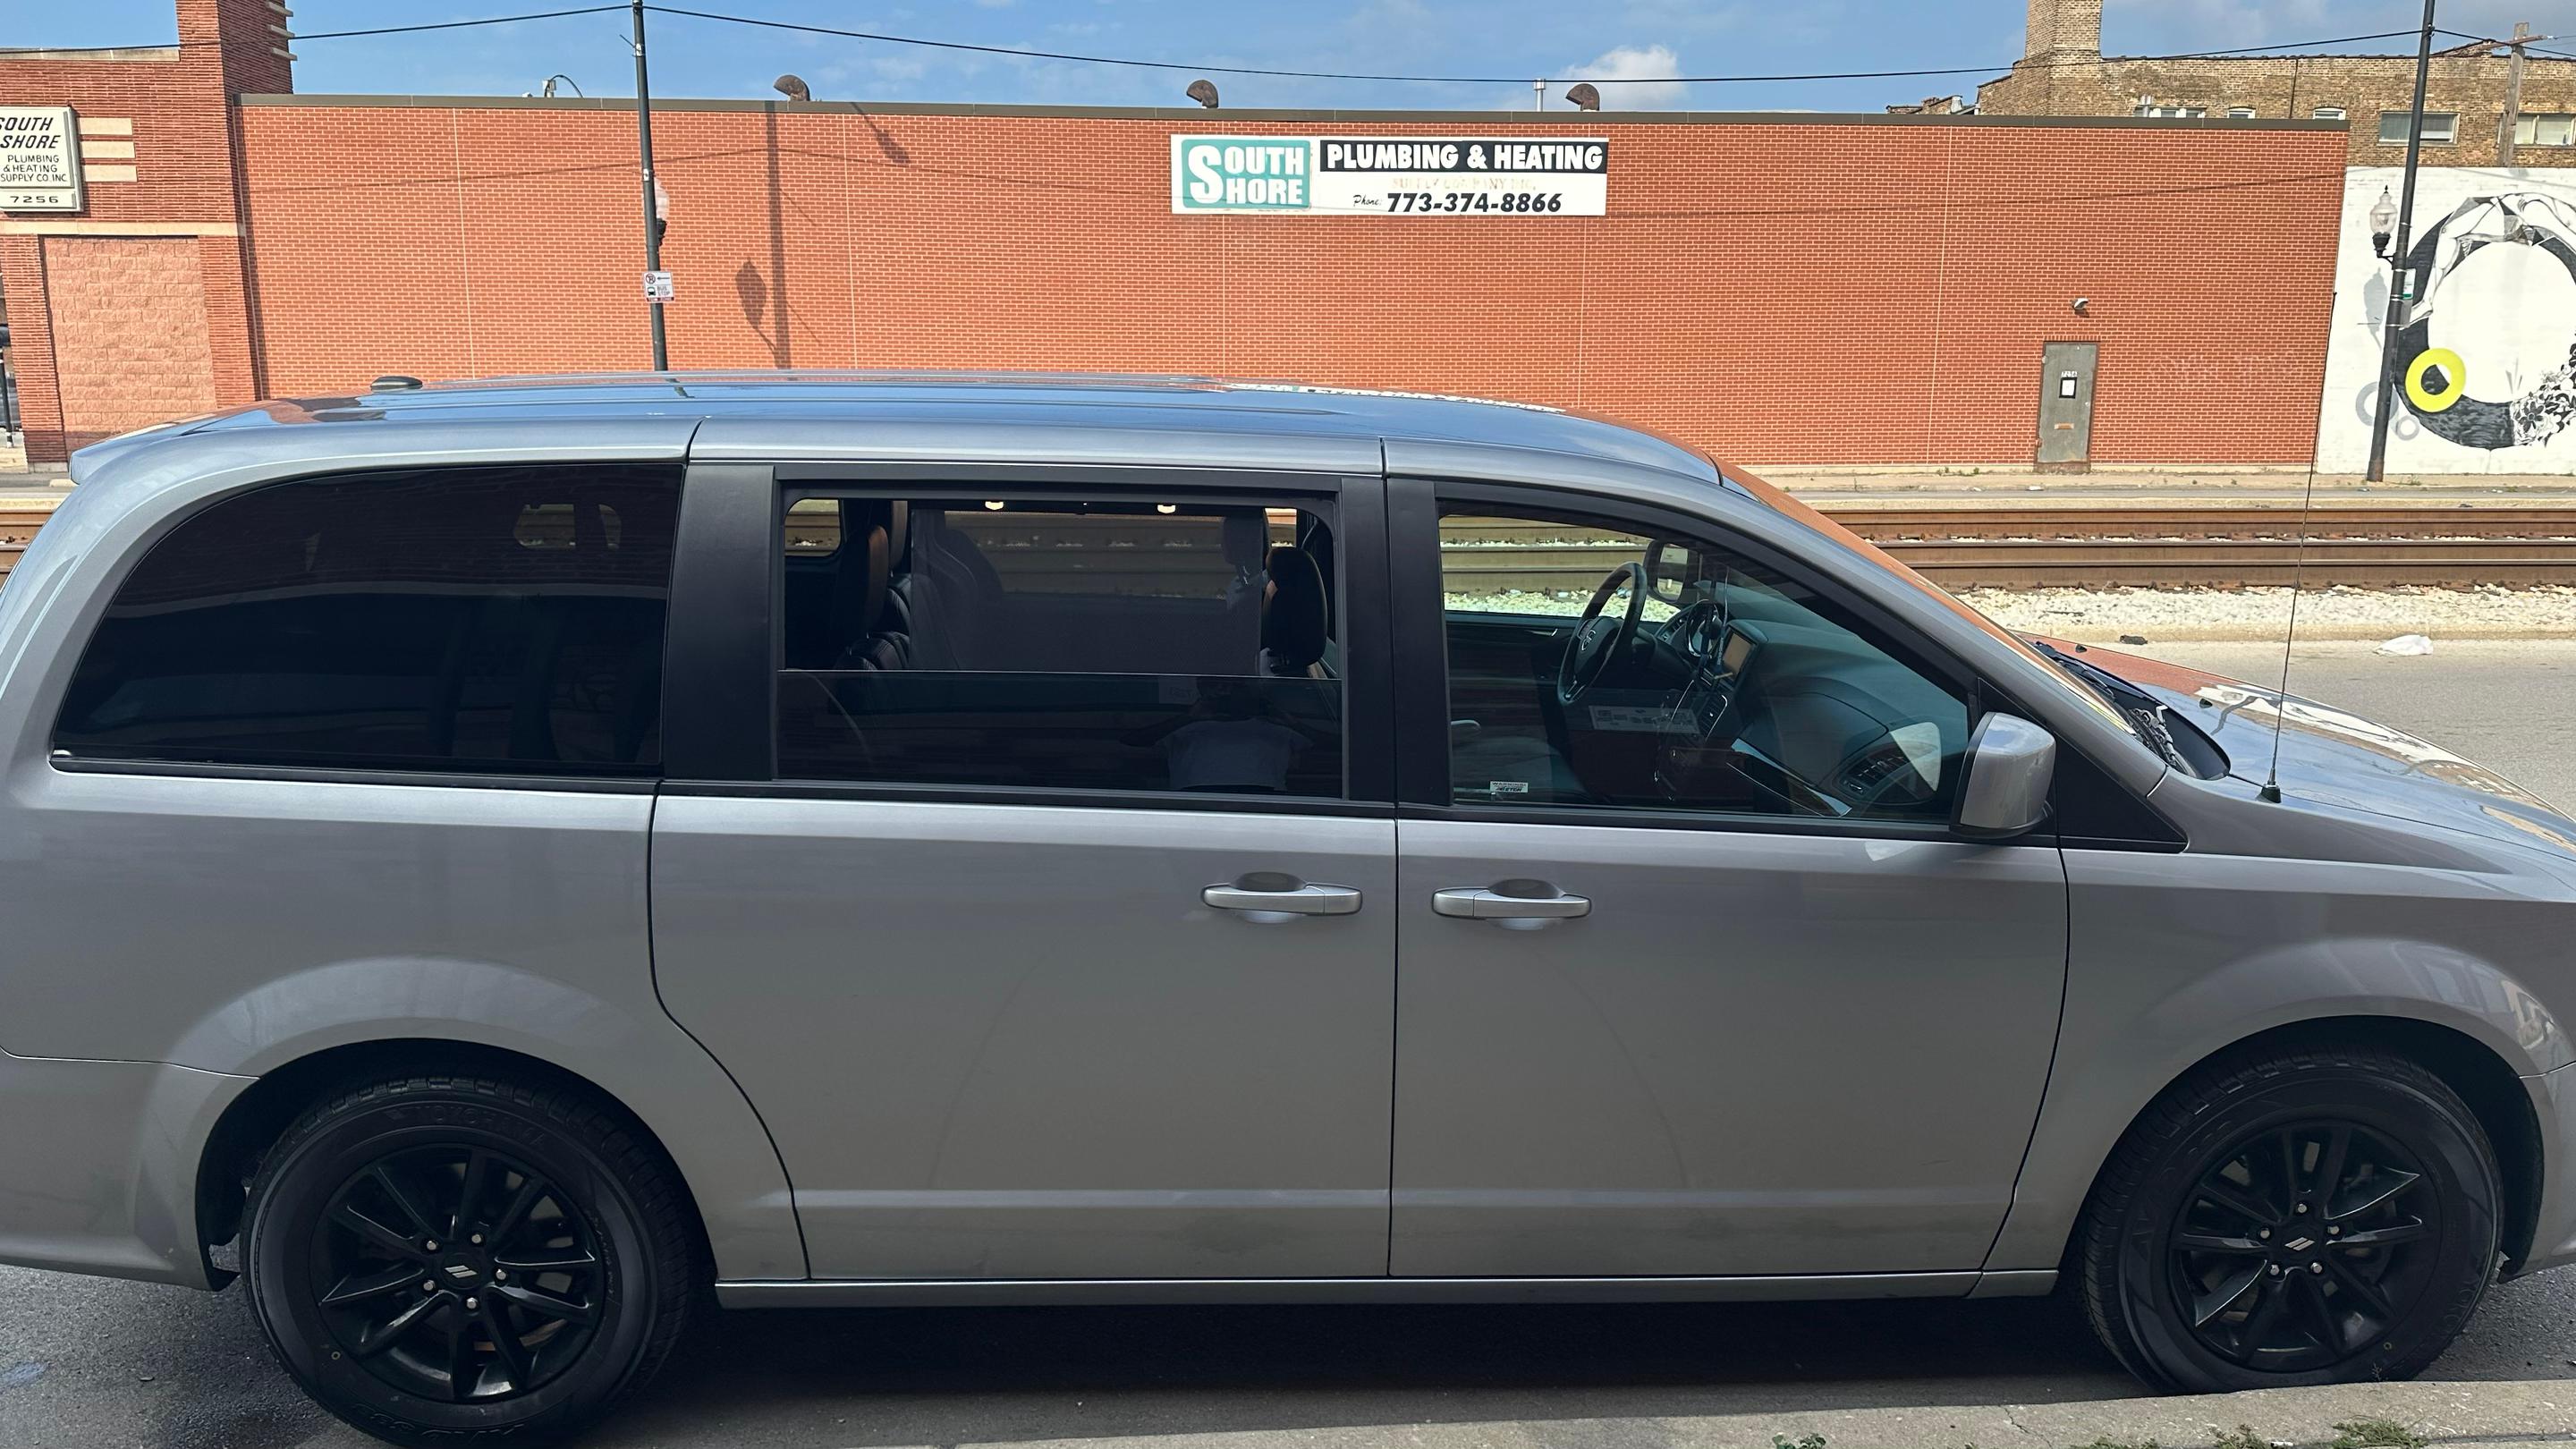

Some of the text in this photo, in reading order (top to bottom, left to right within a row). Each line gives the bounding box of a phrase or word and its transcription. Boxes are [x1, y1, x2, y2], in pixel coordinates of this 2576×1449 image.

[0, 135, 61, 148] SHORE
[7, 155, 59, 163] PLUMBING
[1327, 143, 1603, 170] PLUMBING & HEATING
[4, 165, 57, 173] & HEATING
[1188, 145, 1305, 204] SOUTH
[0, 174, 34, 182] SUPPLY
[1386, 192, 1563, 213] 773-374-8866
